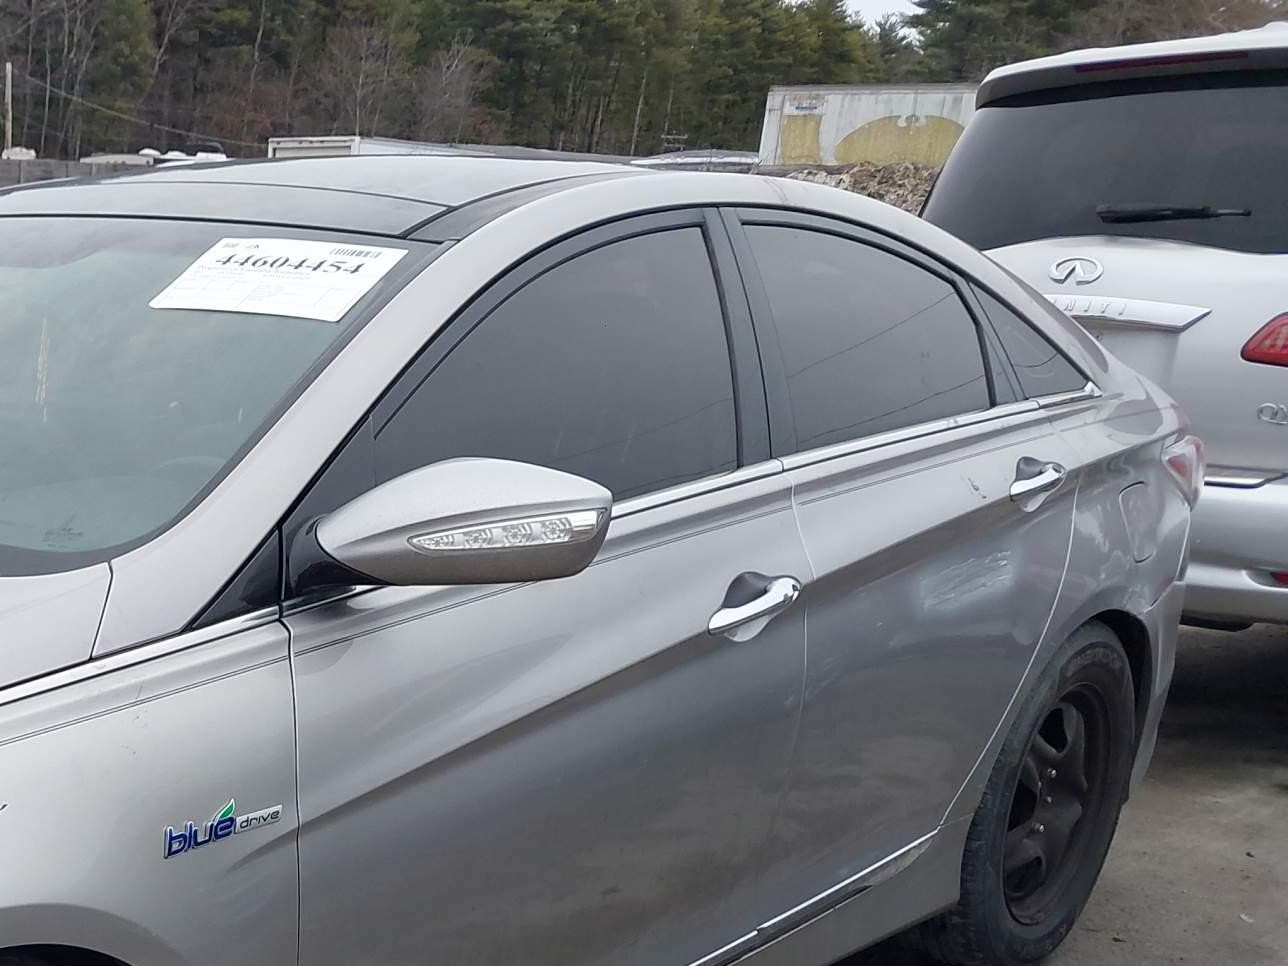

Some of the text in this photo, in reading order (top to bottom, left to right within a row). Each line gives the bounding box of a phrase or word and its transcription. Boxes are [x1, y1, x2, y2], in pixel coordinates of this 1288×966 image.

[215, 253, 366, 275] 44604454
[162, 808, 282, 860] blue drive
